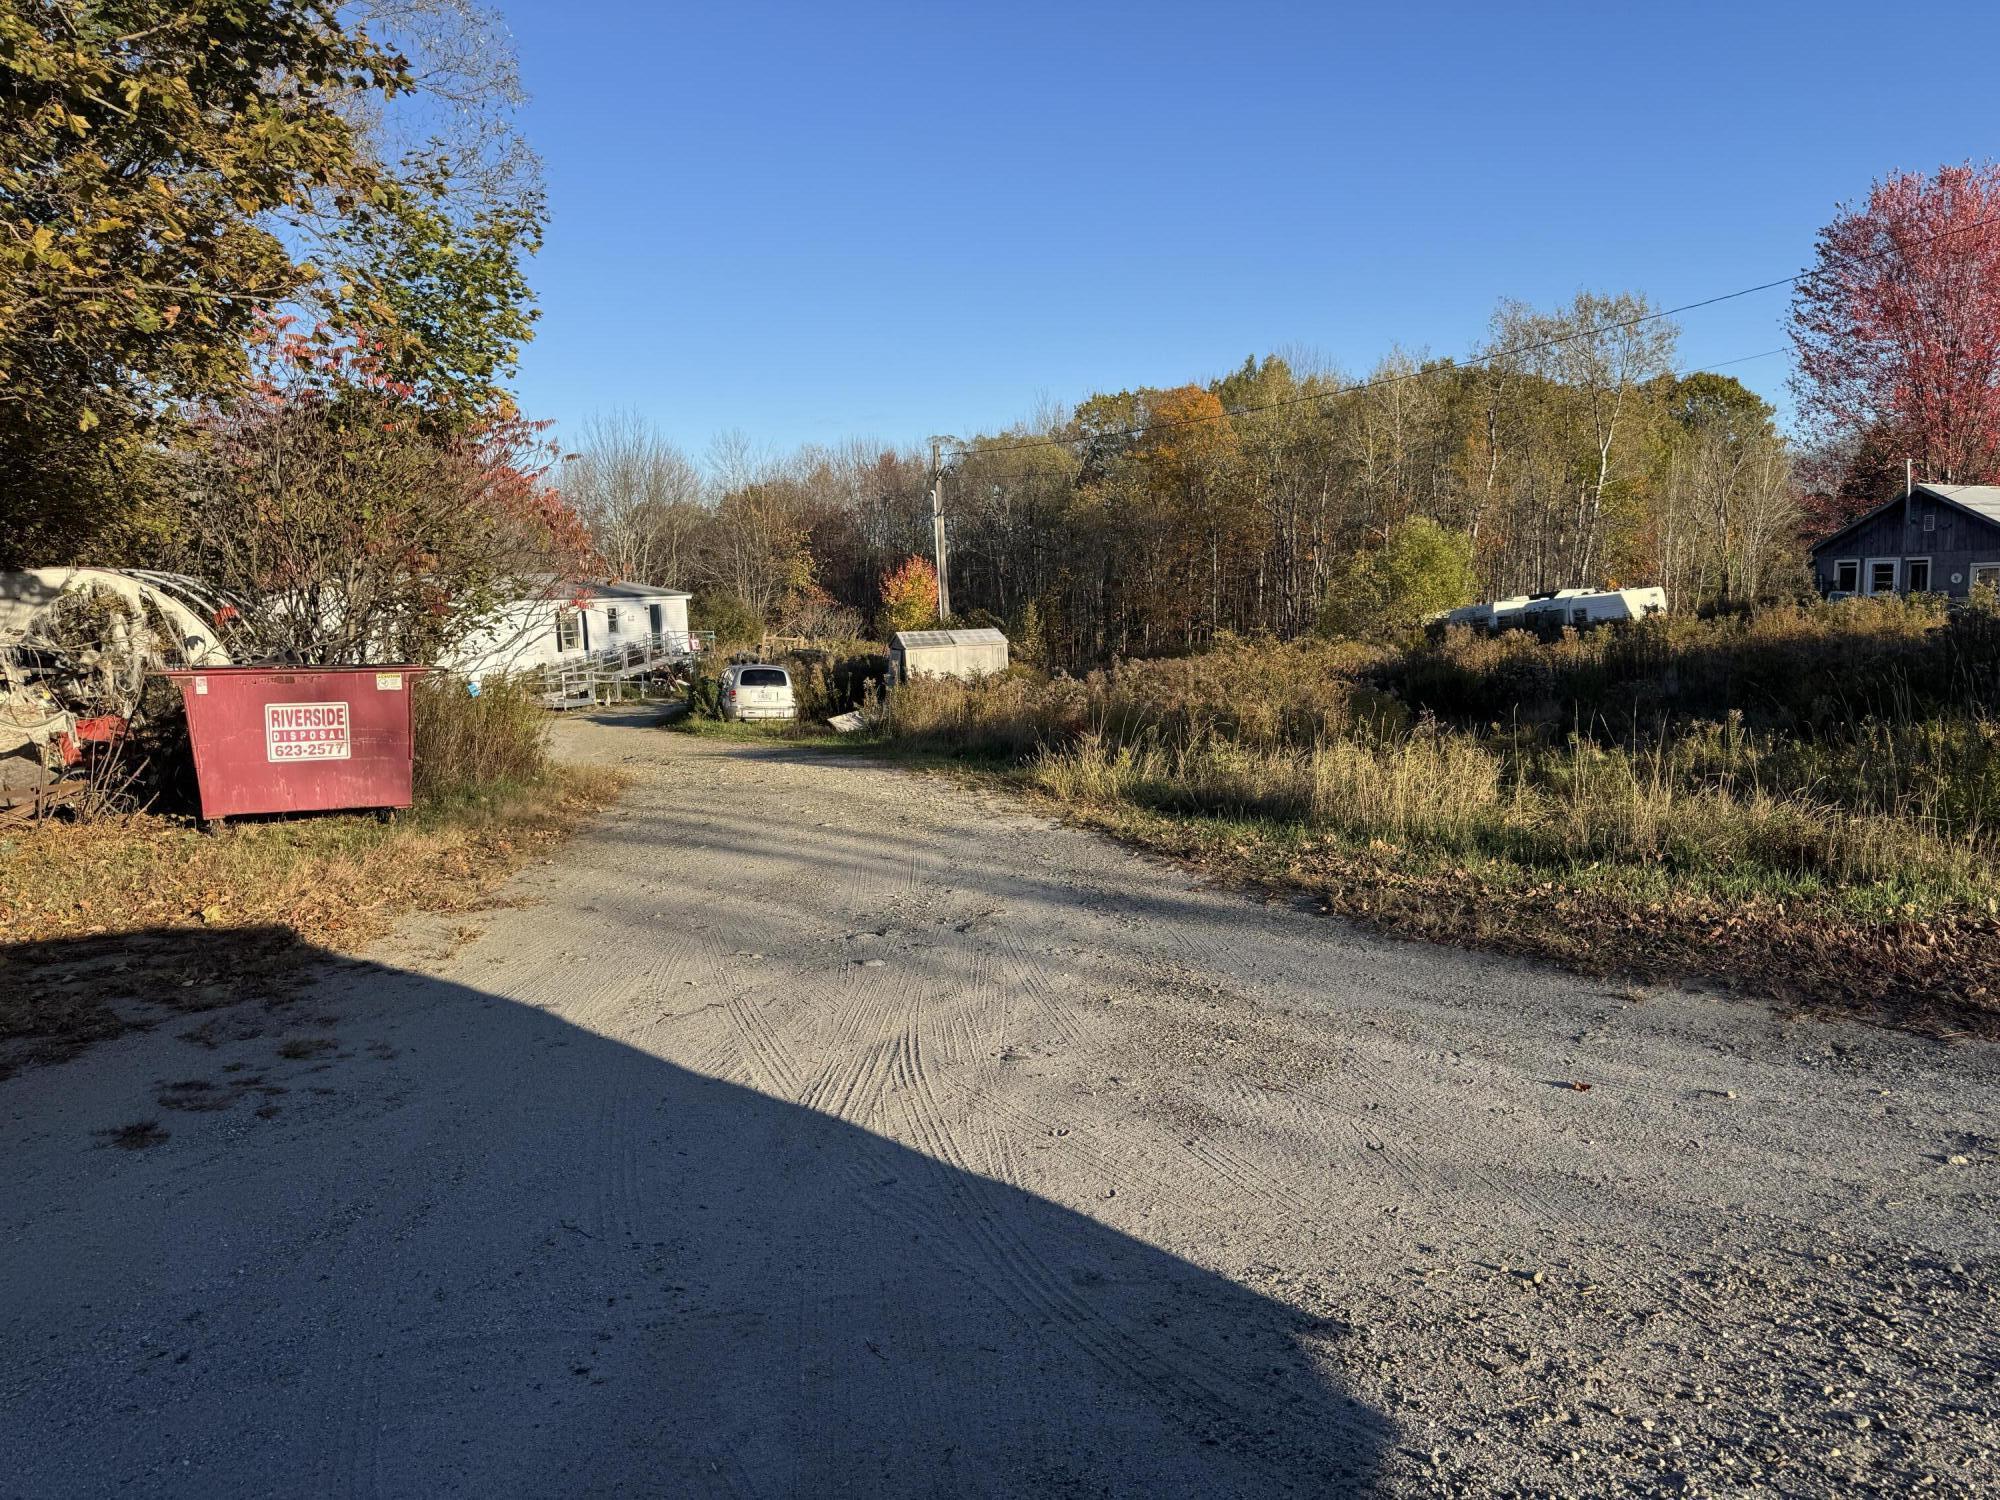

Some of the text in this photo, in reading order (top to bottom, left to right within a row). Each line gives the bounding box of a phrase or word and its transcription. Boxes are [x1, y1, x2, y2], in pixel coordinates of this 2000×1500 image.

[271, 708, 344, 728] RIVERSIDE
[273, 730, 343, 741] DISPOSAL
[275, 744, 343, 757] 623-2577
